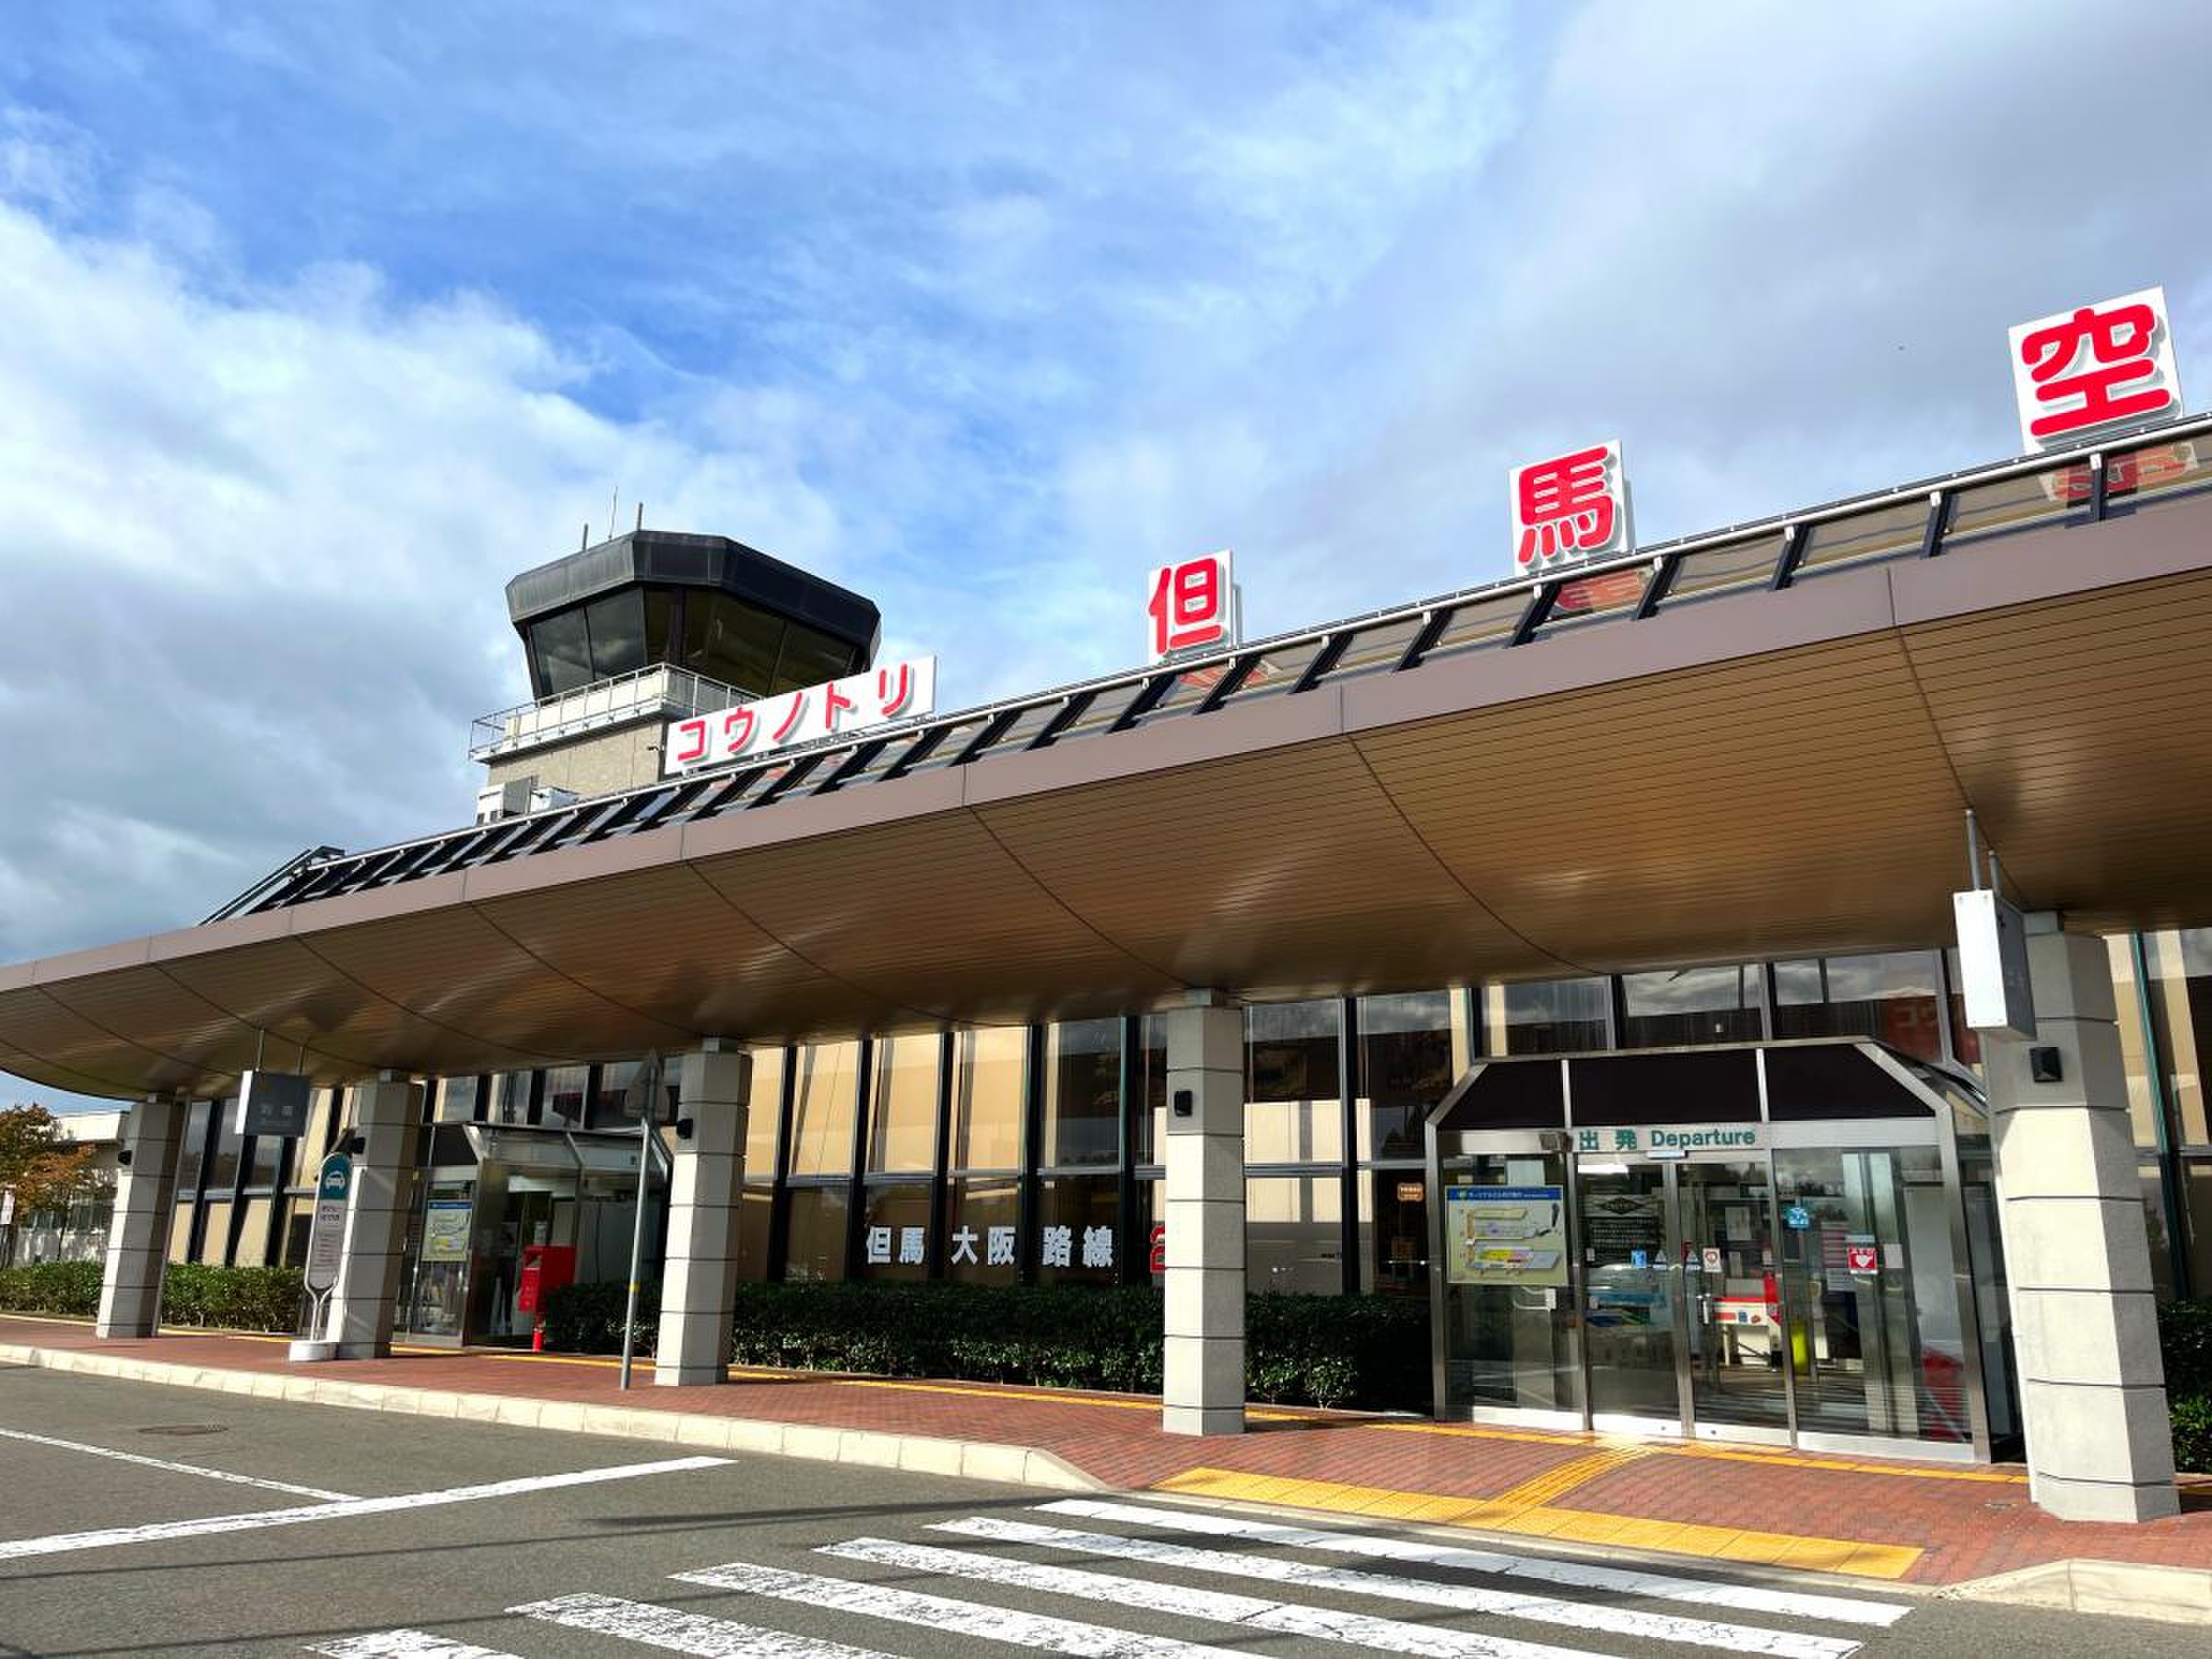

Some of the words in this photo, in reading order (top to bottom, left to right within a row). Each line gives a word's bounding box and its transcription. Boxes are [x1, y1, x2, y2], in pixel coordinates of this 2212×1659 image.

[677, 663, 909, 762] コウノトリ
[1579, 1129, 1638, 1150] 出発
[1651, 1128, 1756, 1149] Departure
[866, 1225, 925, 1265] 但馬
[950, 1225, 1016, 1266] 大阪
[1041, 1225, 1113, 1268] 路線
